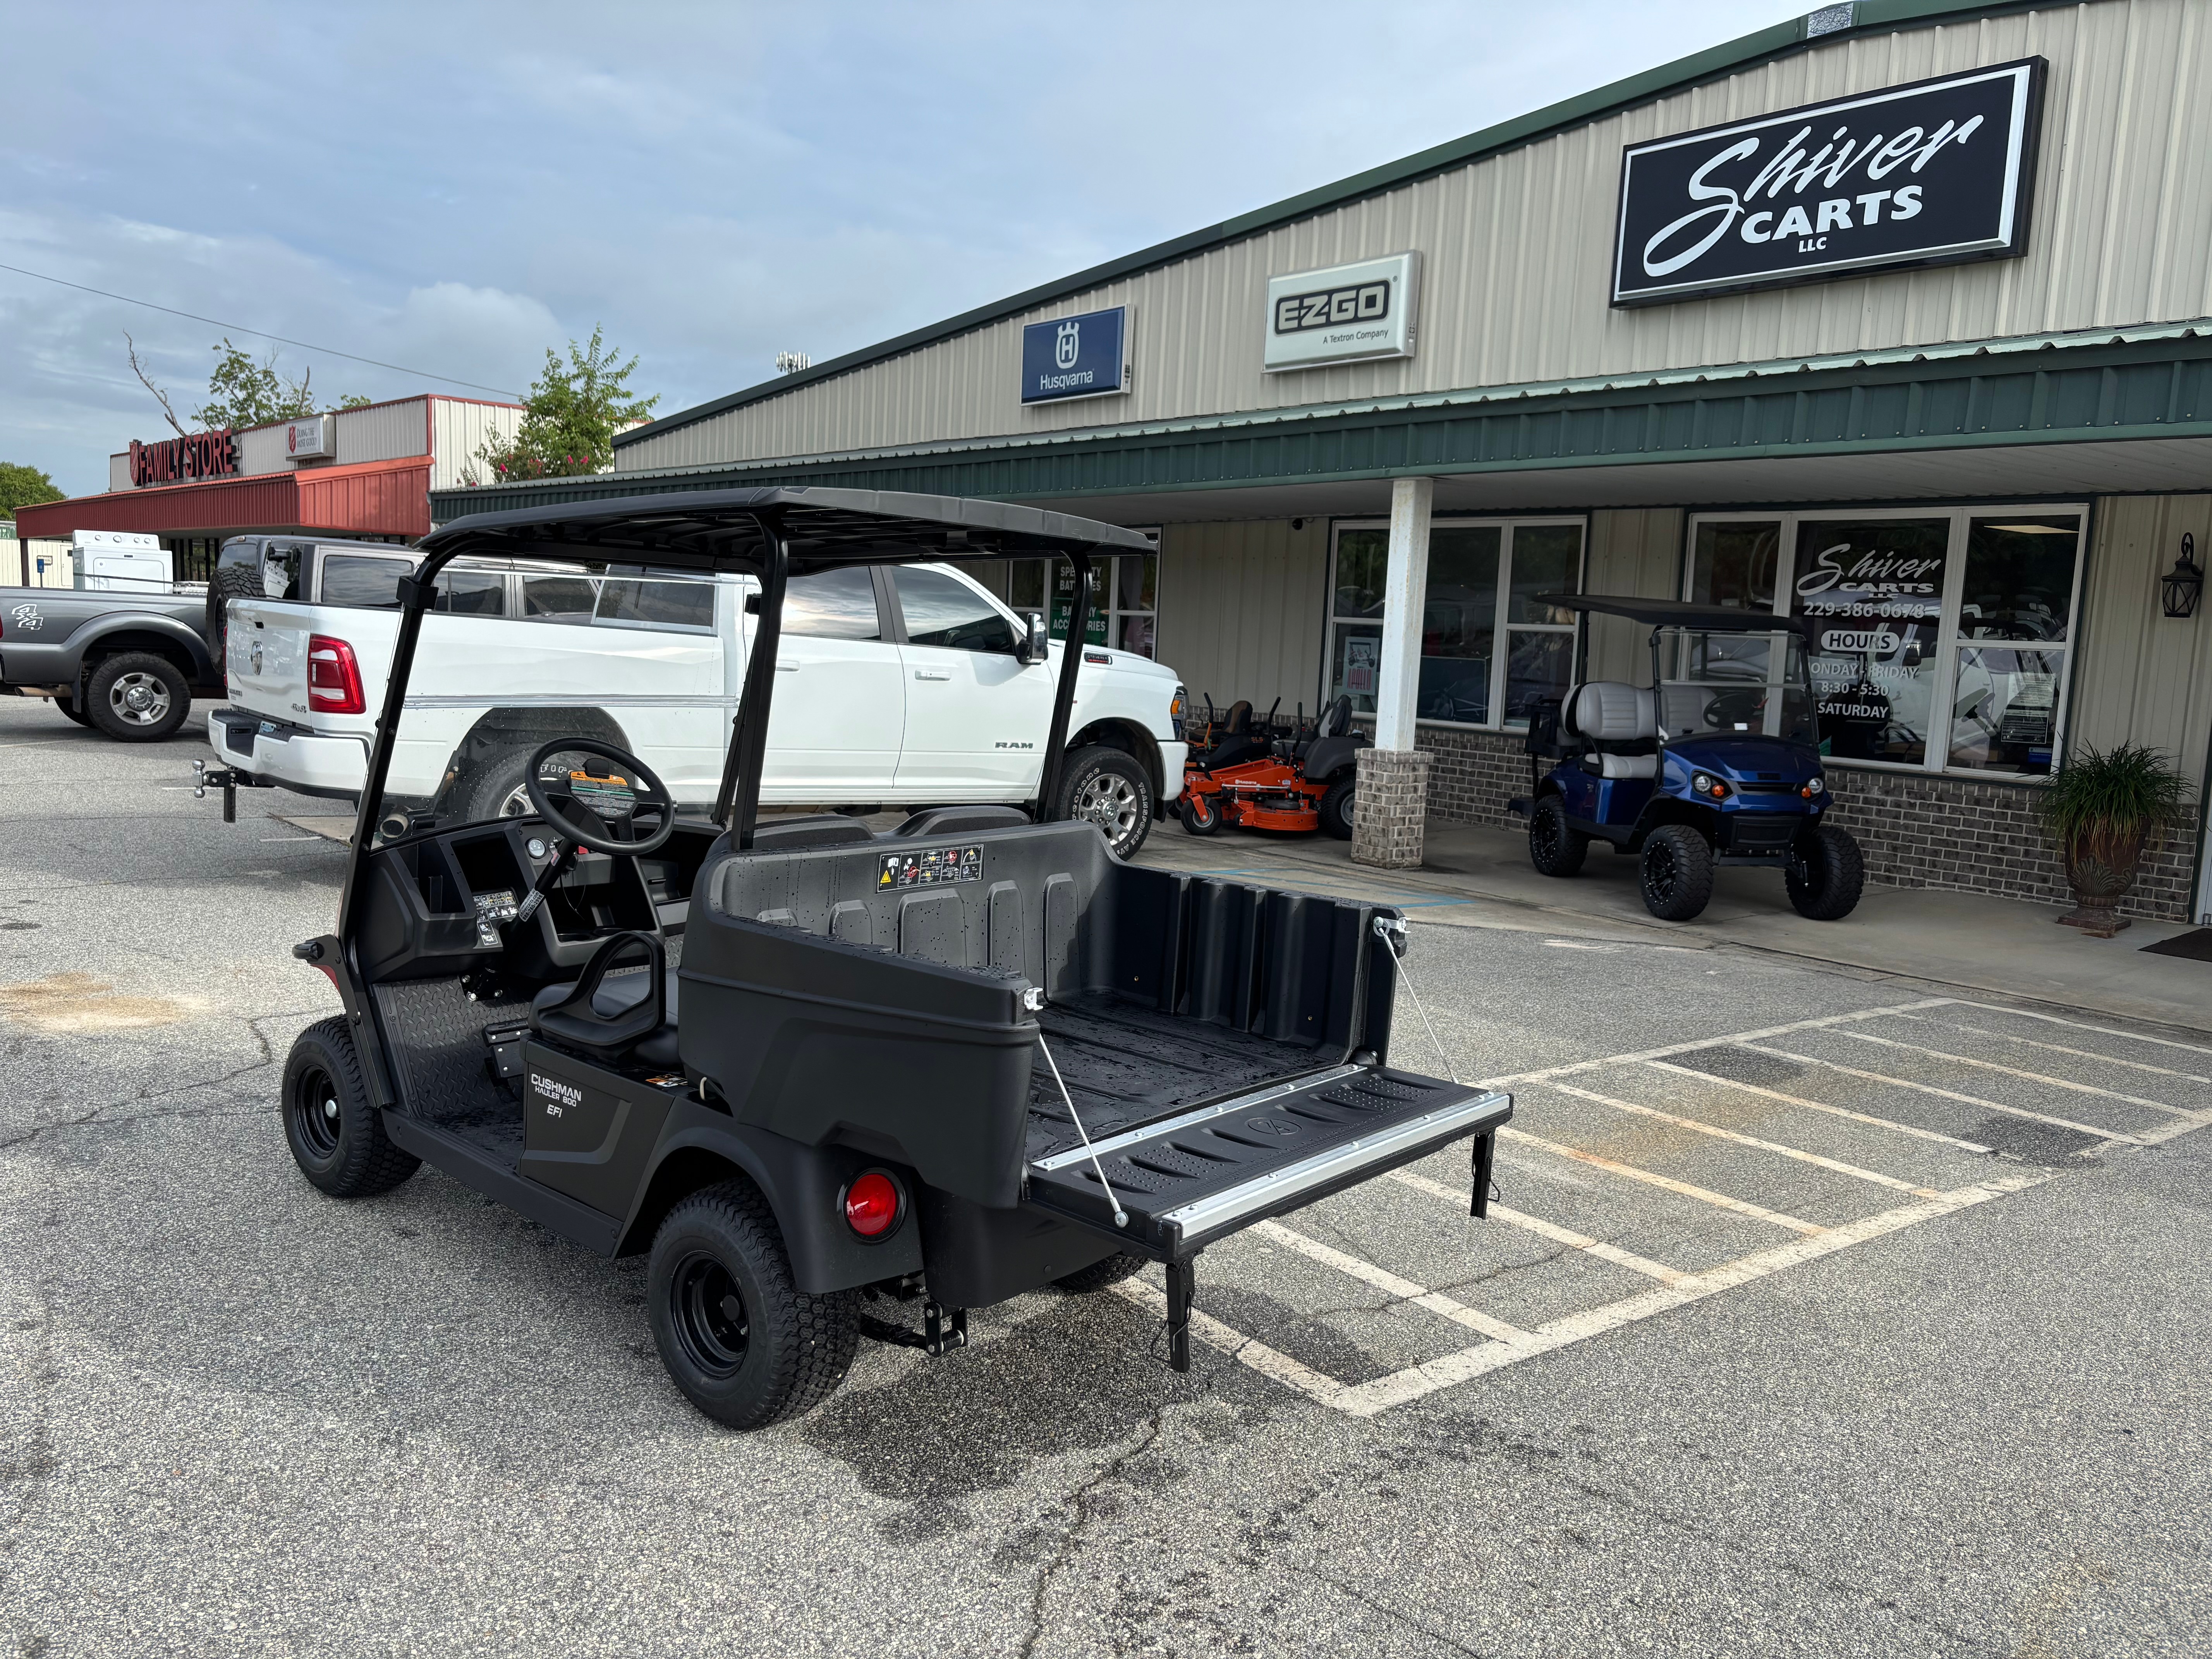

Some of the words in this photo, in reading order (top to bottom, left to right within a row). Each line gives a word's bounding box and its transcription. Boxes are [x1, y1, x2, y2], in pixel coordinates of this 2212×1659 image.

[1644, 115, 1984, 276] Shiver
[1740, 185, 1923, 243] CARTS
[1798, 237, 1827, 253] LLC
[1278, 285, 1386, 330] EZGO
[1323, 336, 1328, 344] A
[1329, 333, 1355, 343] Textron
[1356, 329, 1389, 340] Company
[1040, 371, 1093, 390] Husqvarna
[139, 438, 181, 484] FAMILY
[184, 429, 233, 477] STORE
[1060, 566, 1102, 577] SPETY
[1796, 543, 1941, 596] Shiver
[1060, 580, 1101, 591] BATES
[1839, 582, 1934, 593] CARTS
[1803, 602, 1925, 618] 229-386-0678
[1829, 633, 1891, 649] HOURS
[1799, 662, 1858, 676] ONDAY
[1869, 662, 1918, 679] FRIDAY
[1821, 682, 1849, 694] 8:30
[1860, 684, 1889, 696] 5:30
[1817, 702, 1889, 718] SATURDAY
[531, 1073, 581, 1101] CUSHMAN
[535, 1085, 560, 1101] HAULER
[563, 1096, 577, 1107] 800
[546, 1104, 563, 1118] EFI
